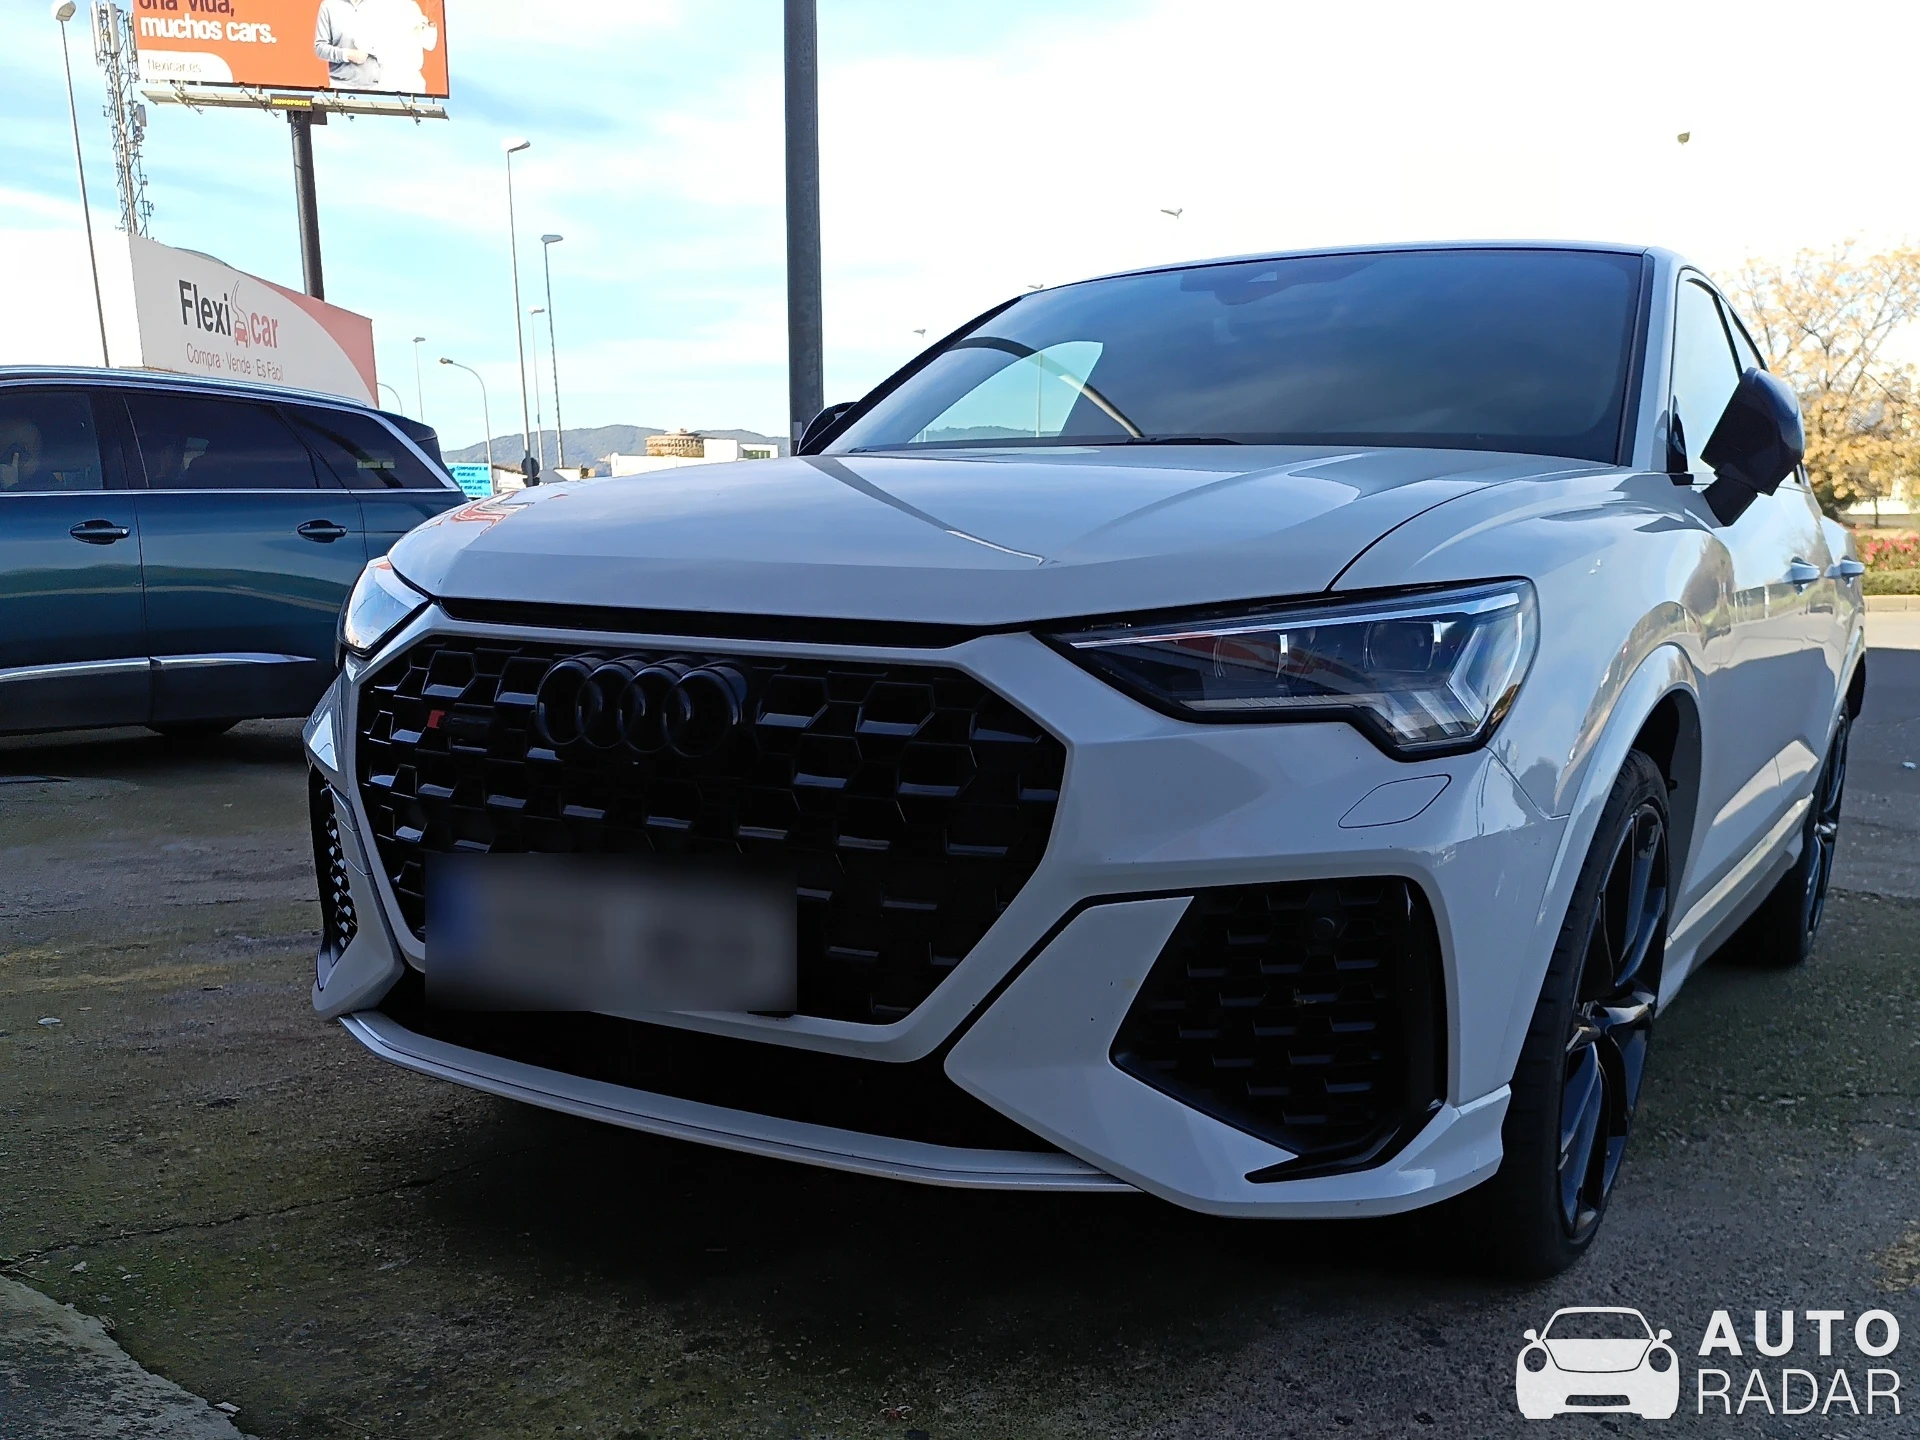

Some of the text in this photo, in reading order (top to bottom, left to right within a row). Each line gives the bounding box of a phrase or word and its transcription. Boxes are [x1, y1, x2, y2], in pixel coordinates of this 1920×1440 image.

[140, 12, 277, 44] muchos cars.
[186, 342, 221, 371] Compra
[226, 351, 251, 375] Vende
[255, 358, 266, 378] Es
